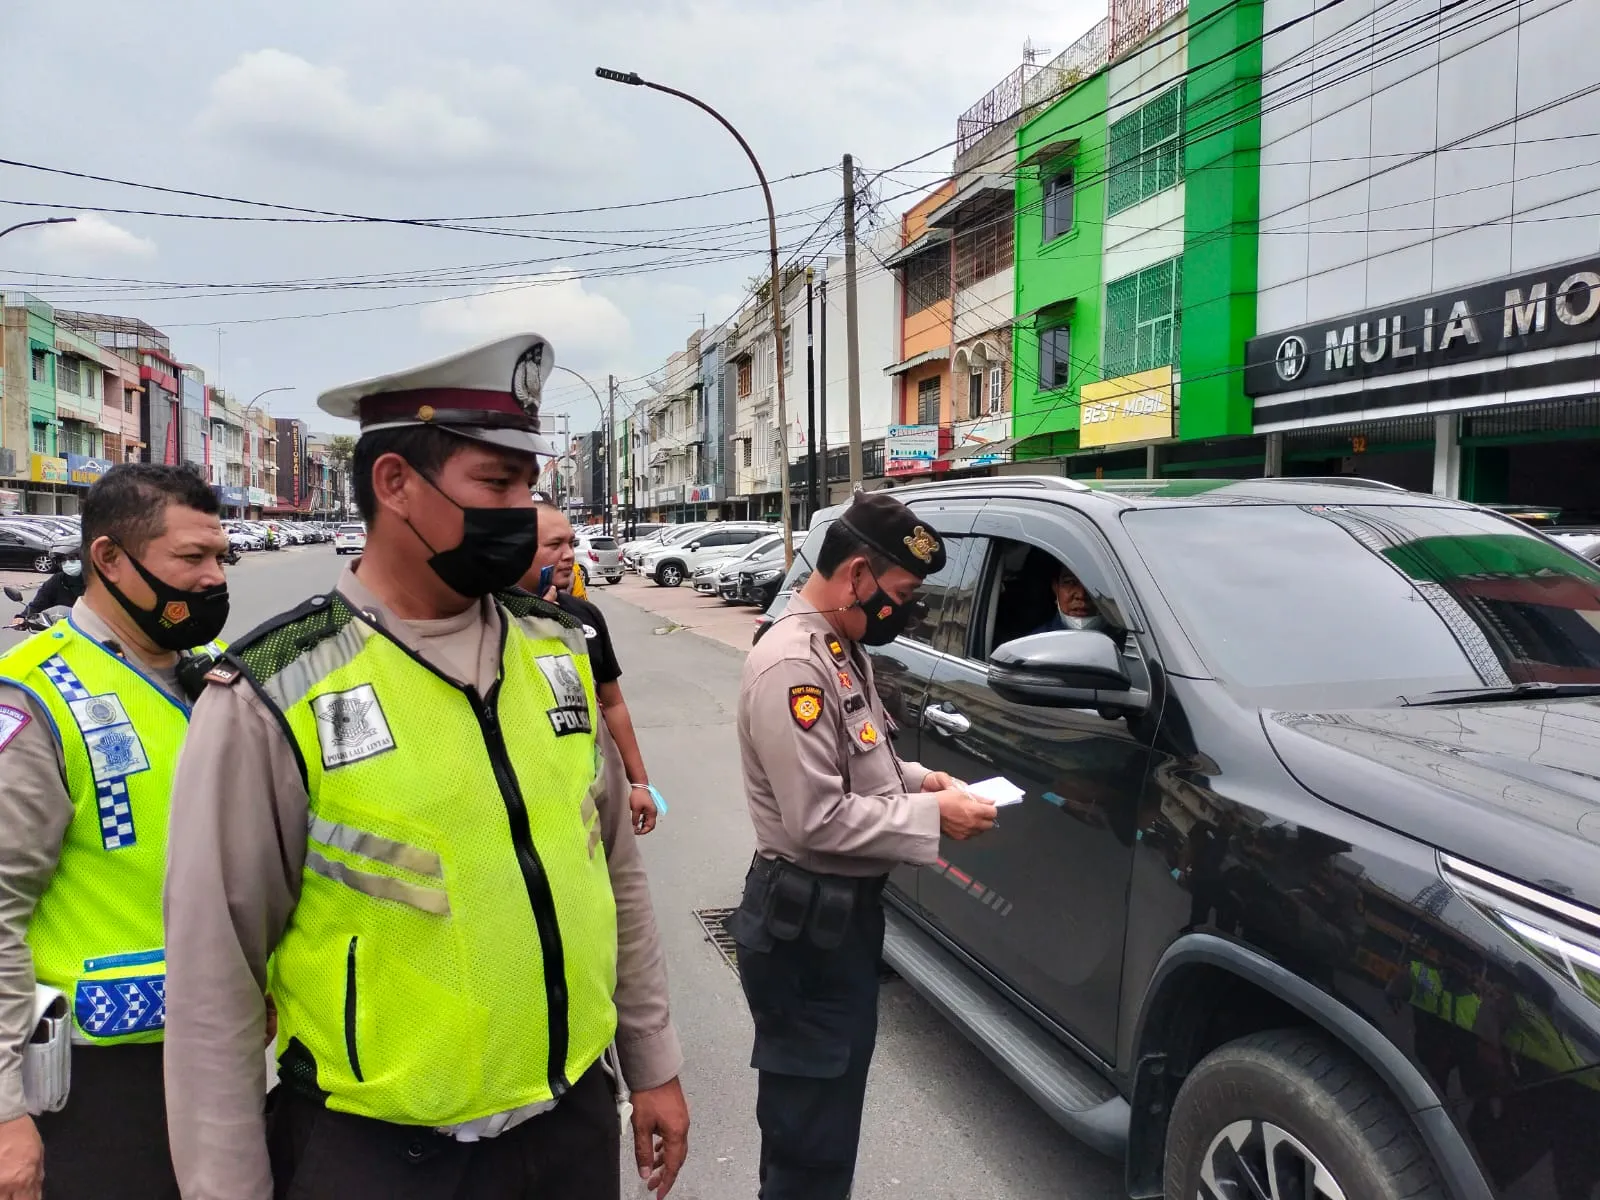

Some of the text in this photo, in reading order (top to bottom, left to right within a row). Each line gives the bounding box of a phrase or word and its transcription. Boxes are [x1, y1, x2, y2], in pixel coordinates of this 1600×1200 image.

[1325, 271, 1600, 371] MULIA MO
[1083, 392, 1167, 425] BEST MOBIL
